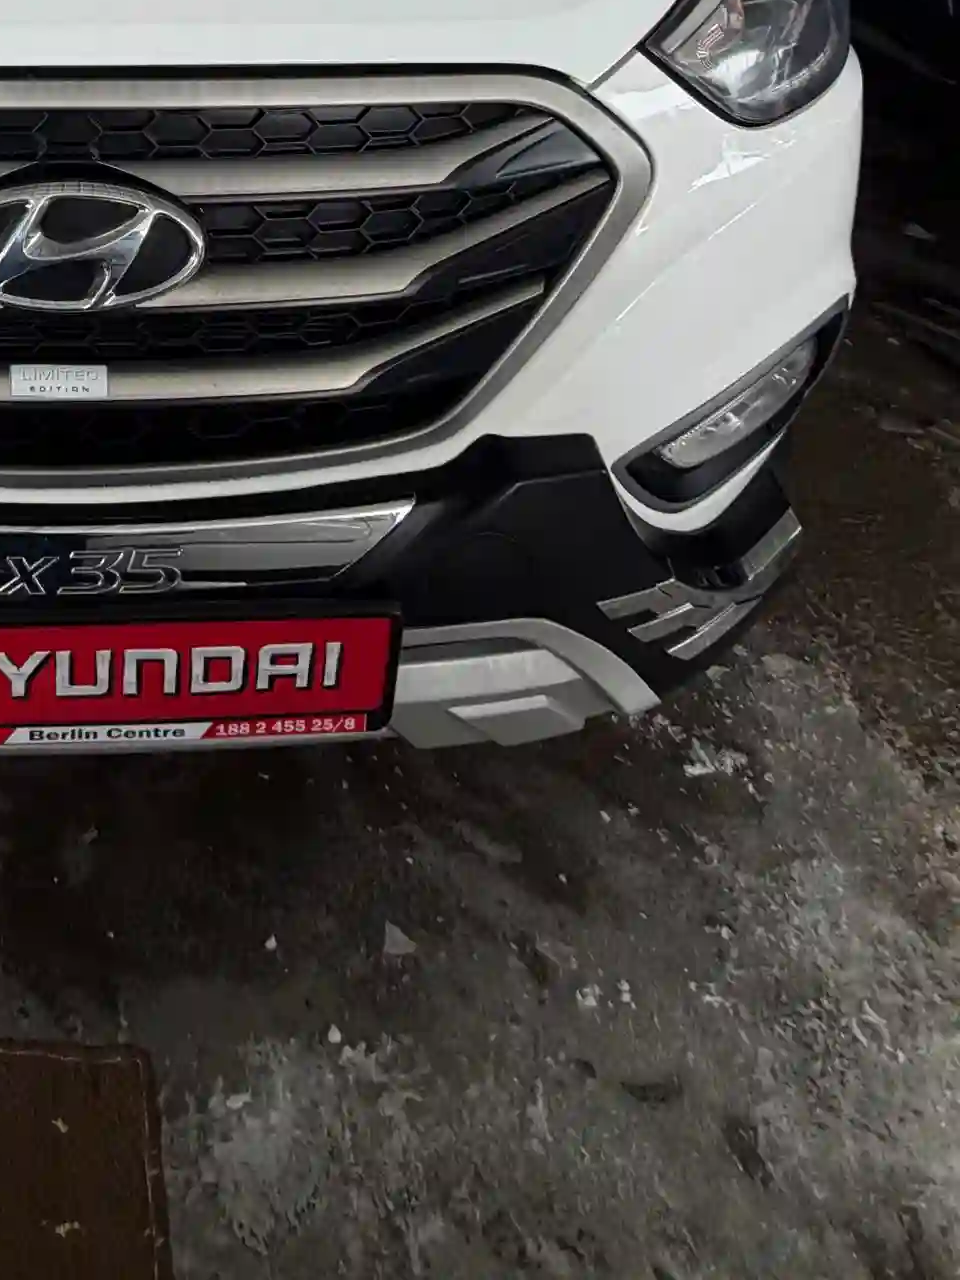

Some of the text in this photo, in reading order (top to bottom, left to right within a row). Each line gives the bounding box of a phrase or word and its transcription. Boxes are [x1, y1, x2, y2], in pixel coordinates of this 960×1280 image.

[28, 725, 187, 742] Berlin Centre
[255, 722, 267, 735] 2
[271, 720, 306, 733] 455
